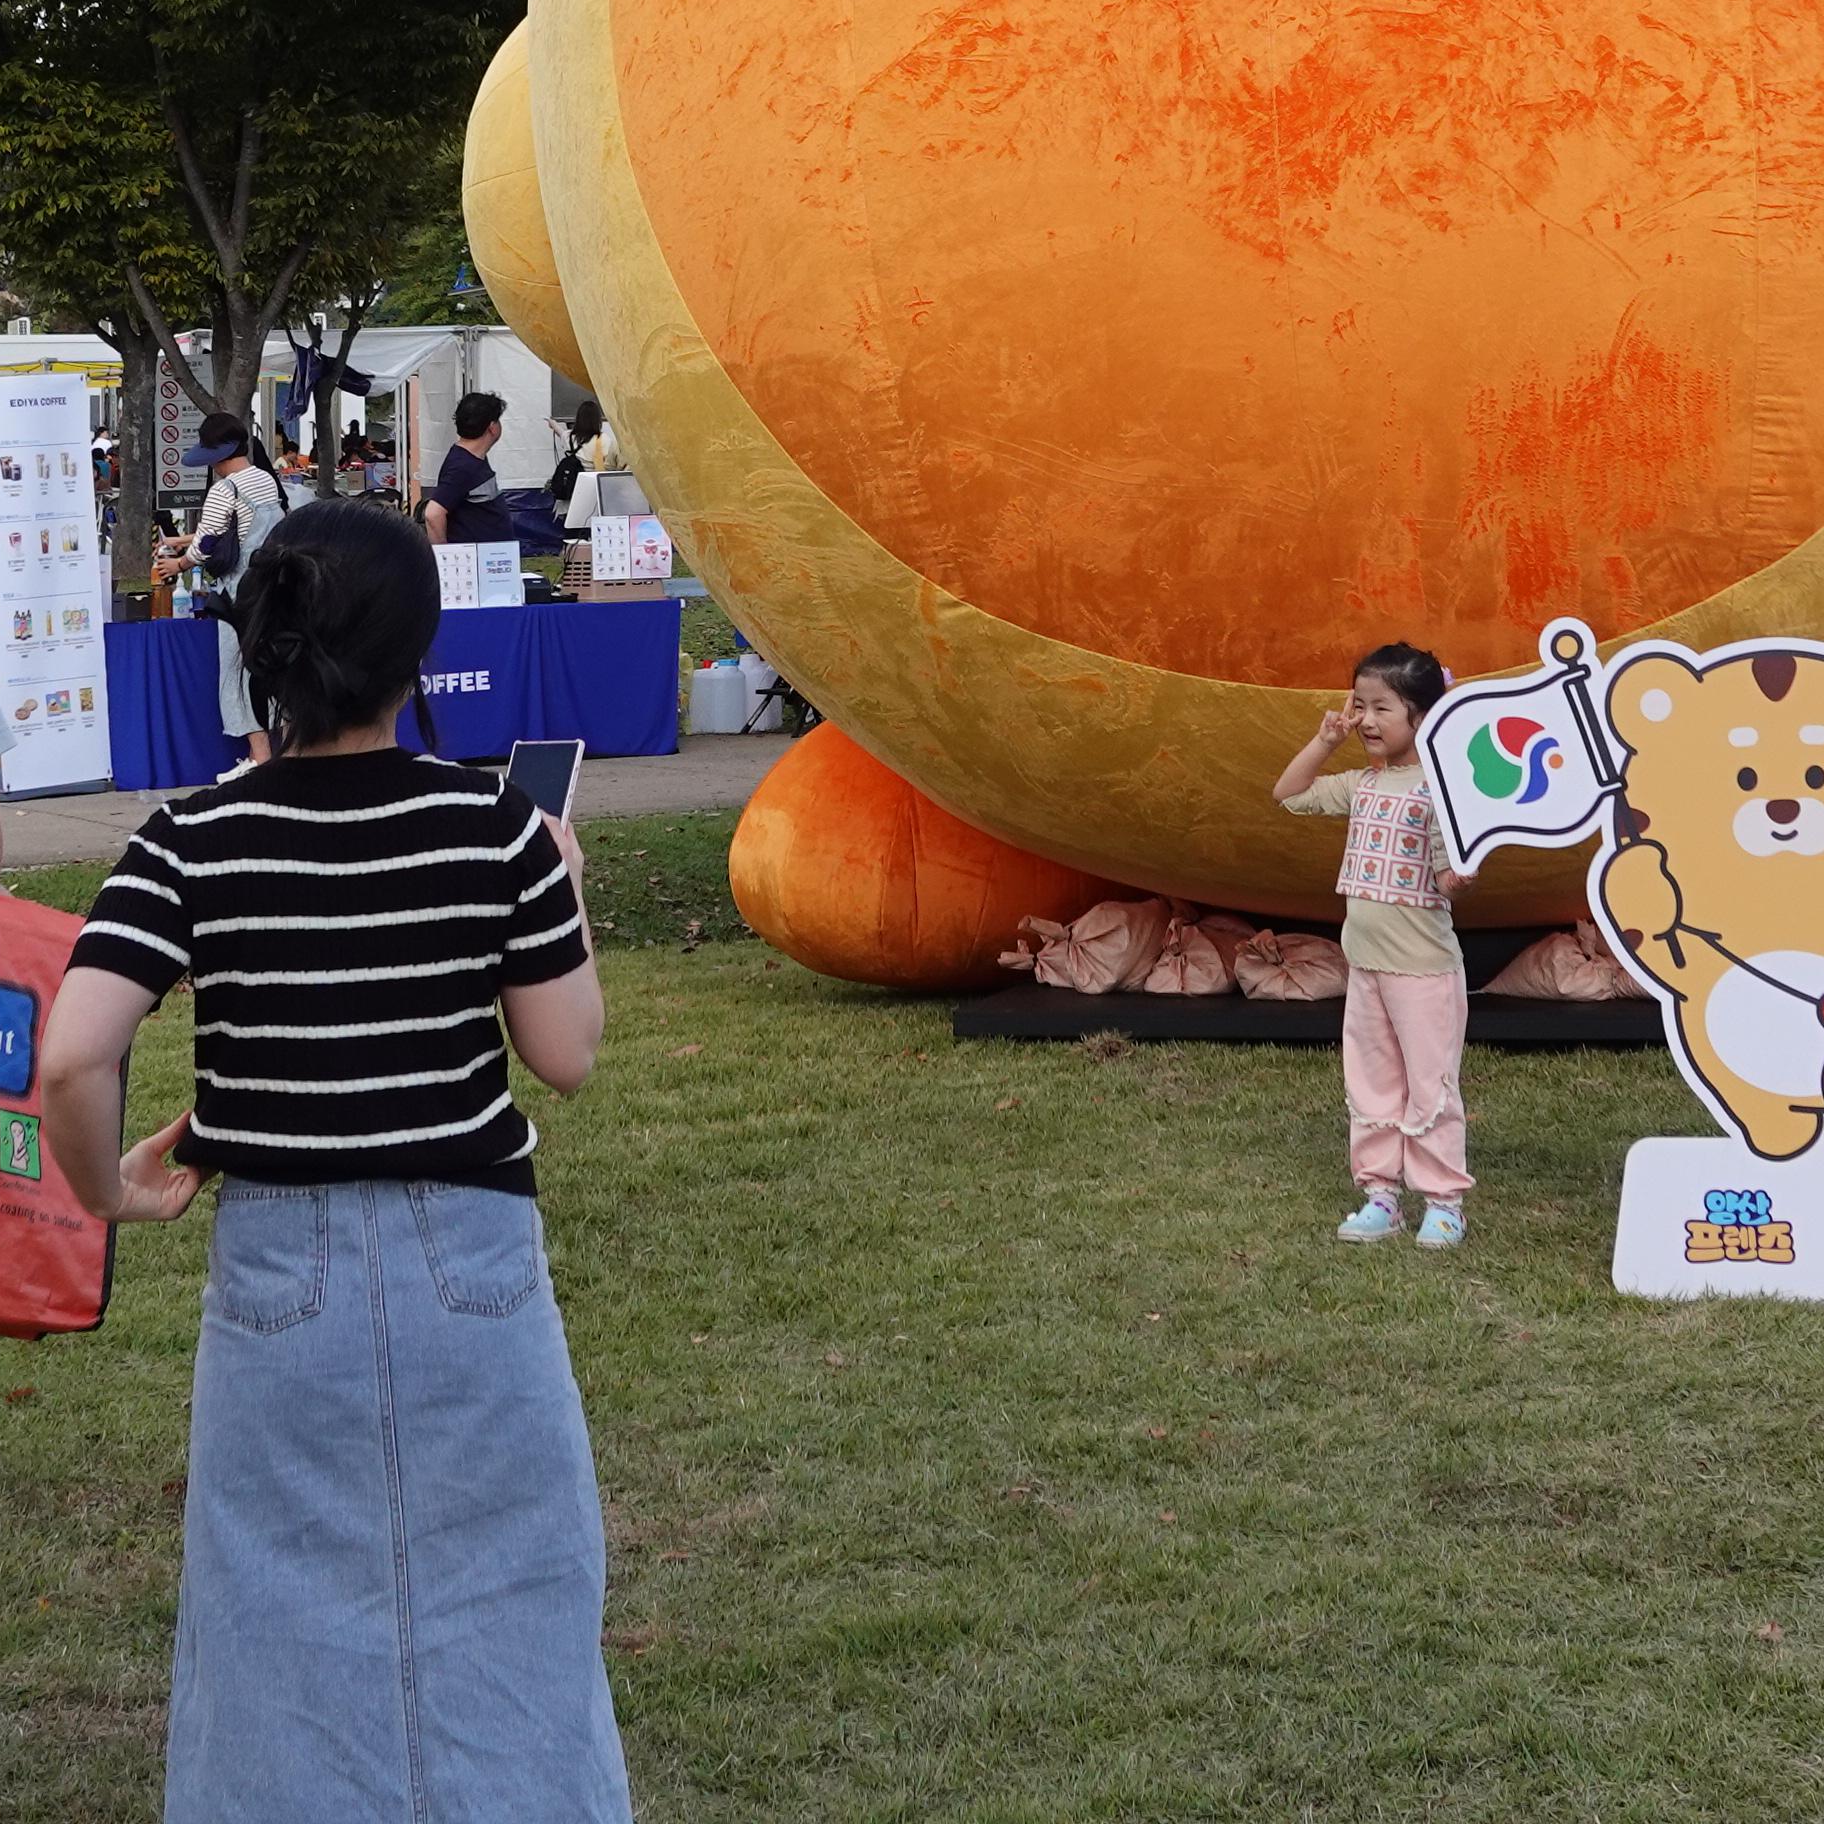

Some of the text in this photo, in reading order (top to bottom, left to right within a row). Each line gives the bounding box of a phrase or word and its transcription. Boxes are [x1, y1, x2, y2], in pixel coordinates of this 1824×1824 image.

[9, 396, 68, 407] EDIYA COFFEE
[420, 670, 491, 696] OFFEE
[0, 1202, 36, 1223] coating
[1703, 1189, 1774, 1225] 양산
[1684, 1219, 1796, 1264] 프렌즈
